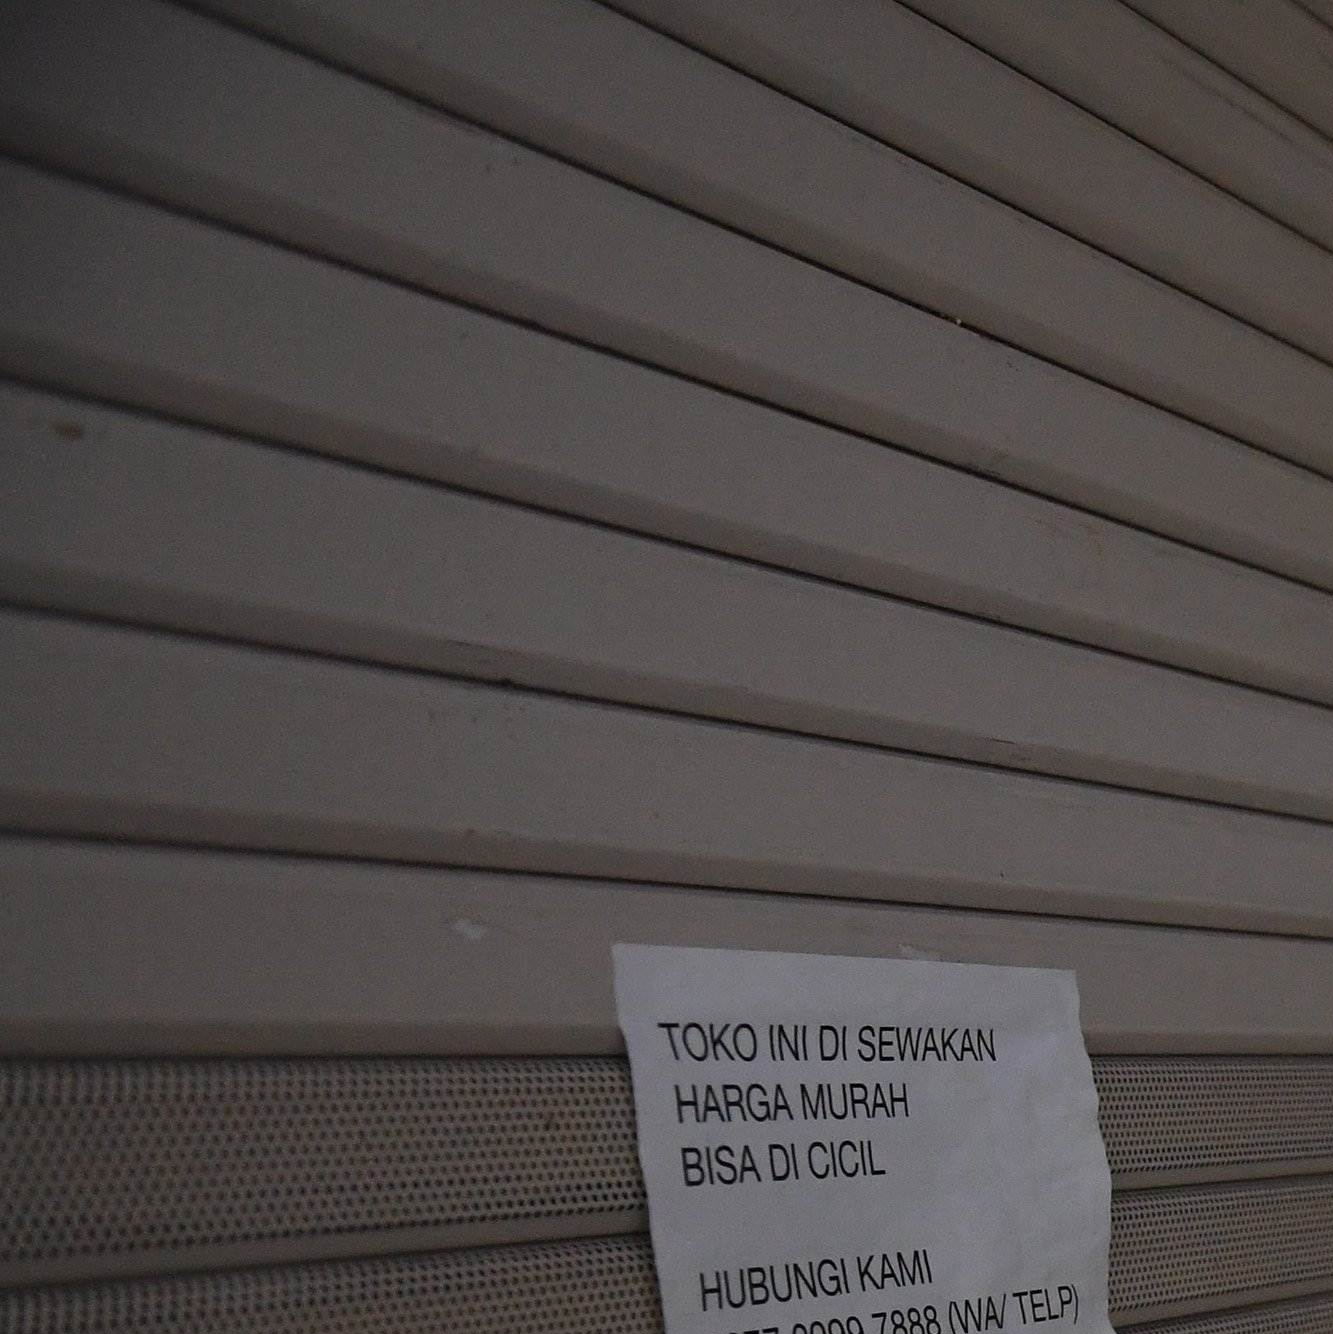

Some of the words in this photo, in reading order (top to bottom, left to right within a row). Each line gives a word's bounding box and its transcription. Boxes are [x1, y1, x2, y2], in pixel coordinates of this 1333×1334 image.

[657, 1022, 758, 1062] TOKO
[769, 1024, 808, 1061] INI
[820, 1025, 848, 1061] DI
[857, 1025, 997, 1062] SEWAKAN
[674, 1083, 794, 1123] HARGA
[800, 1083, 909, 1120] MURAH
[681, 1145, 762, 1187] BISA
[768, 1143, 799, 1181] DI
[808, 1140, 886, 1180] CICIL
[700, 1258, 850, 1311] HUBUNGI
[856, 1249, 933, 1292] KAMI
[1012, 1284, 1079, 1325] TELP)
